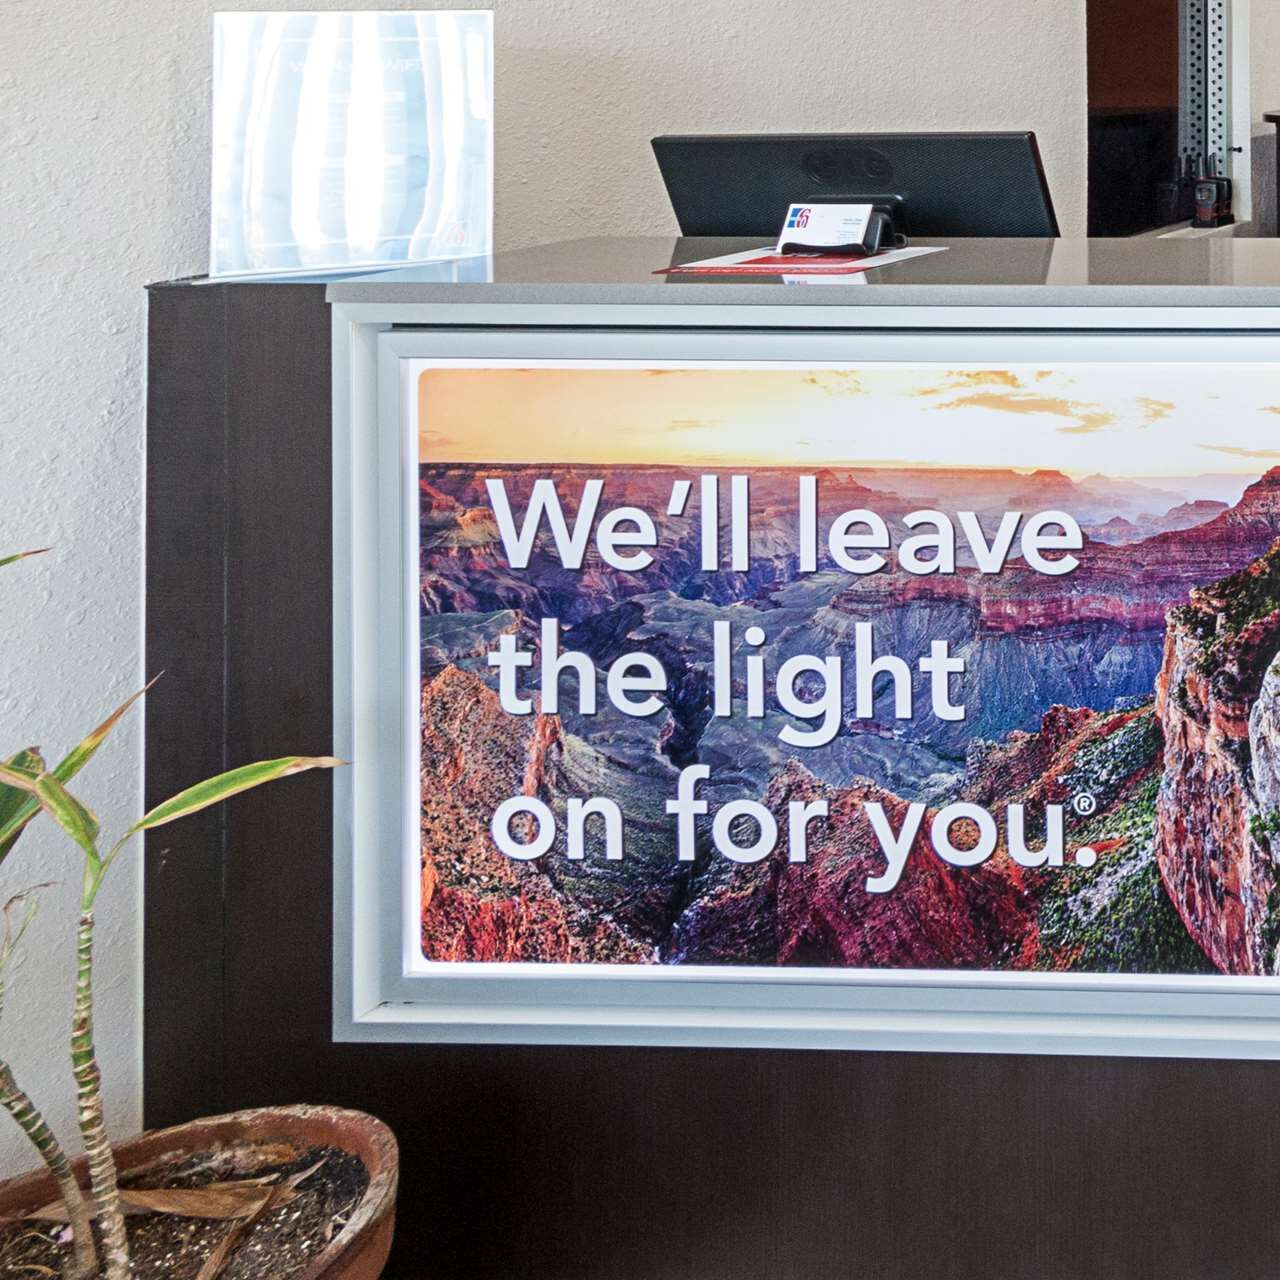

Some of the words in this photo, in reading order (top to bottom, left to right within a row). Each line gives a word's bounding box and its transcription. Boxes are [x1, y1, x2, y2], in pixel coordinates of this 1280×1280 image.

[486, 475, 749, 573] We'll
[799, 475, 1083, 575] leave
[488, 617, 667, 717] the
[713, 620, 966, 748] light
[491, 793, 623, 862] on
[667, 764, 828, 865] for
